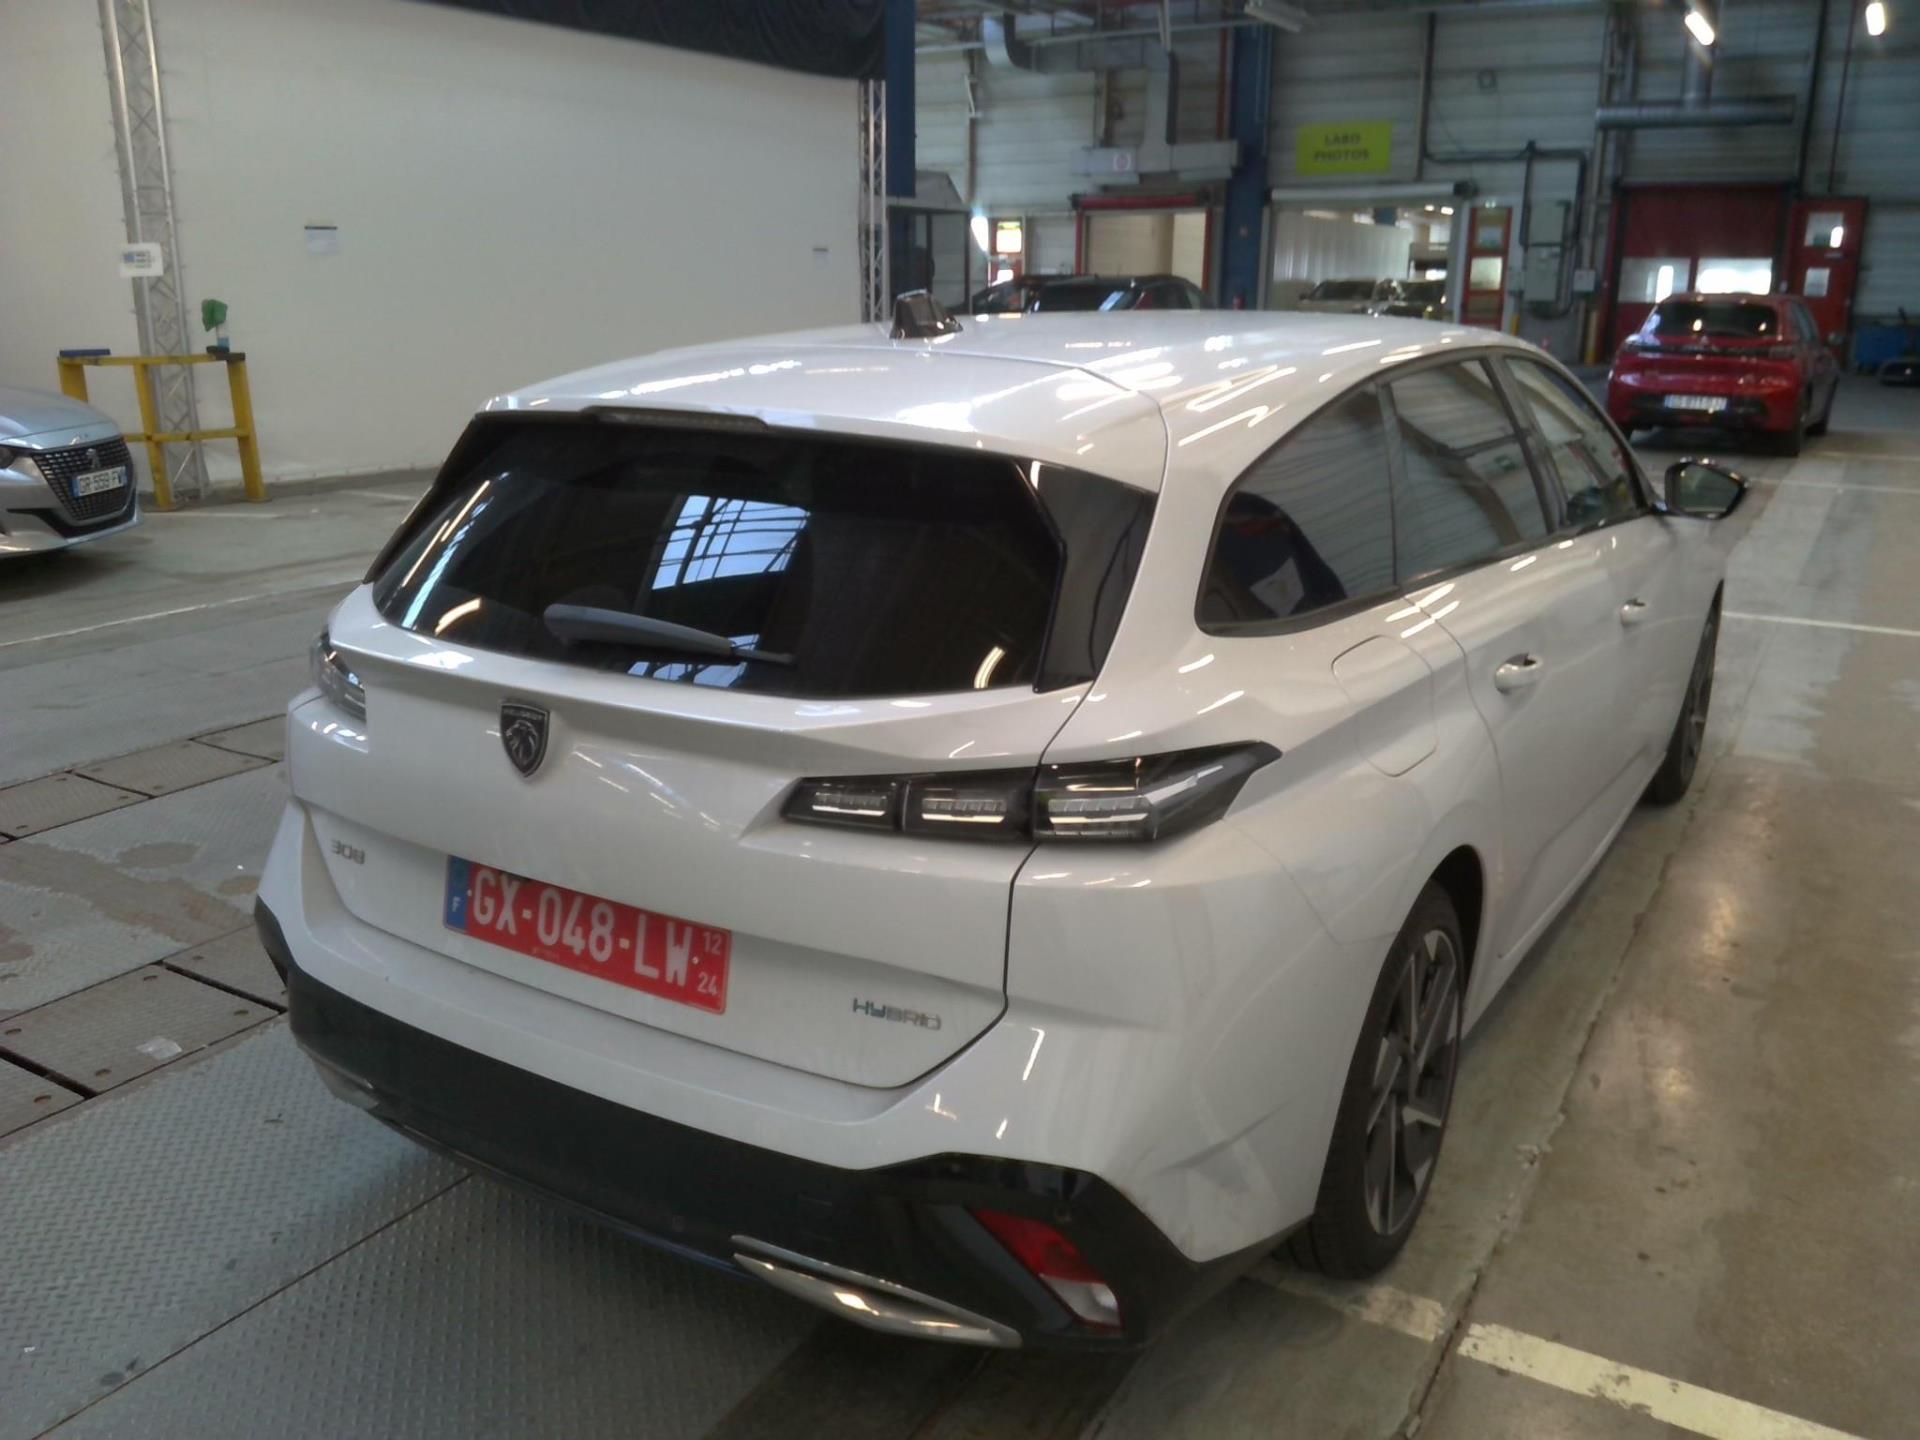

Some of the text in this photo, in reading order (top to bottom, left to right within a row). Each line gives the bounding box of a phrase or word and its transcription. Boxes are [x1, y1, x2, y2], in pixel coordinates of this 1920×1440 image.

[1323, 132, 1362, 146] LABO
[1313, 147, 1370, 162] PHOTOS
[330, 838, 366, 865] 308
[451, 896, 461, 912] F
[472, 868, 694, 987] GX-048-LW
[703, 931, 722, 955] 12
[696, 972, 718, 995] 24
[852, 997, 942, 1031] HYBRID
